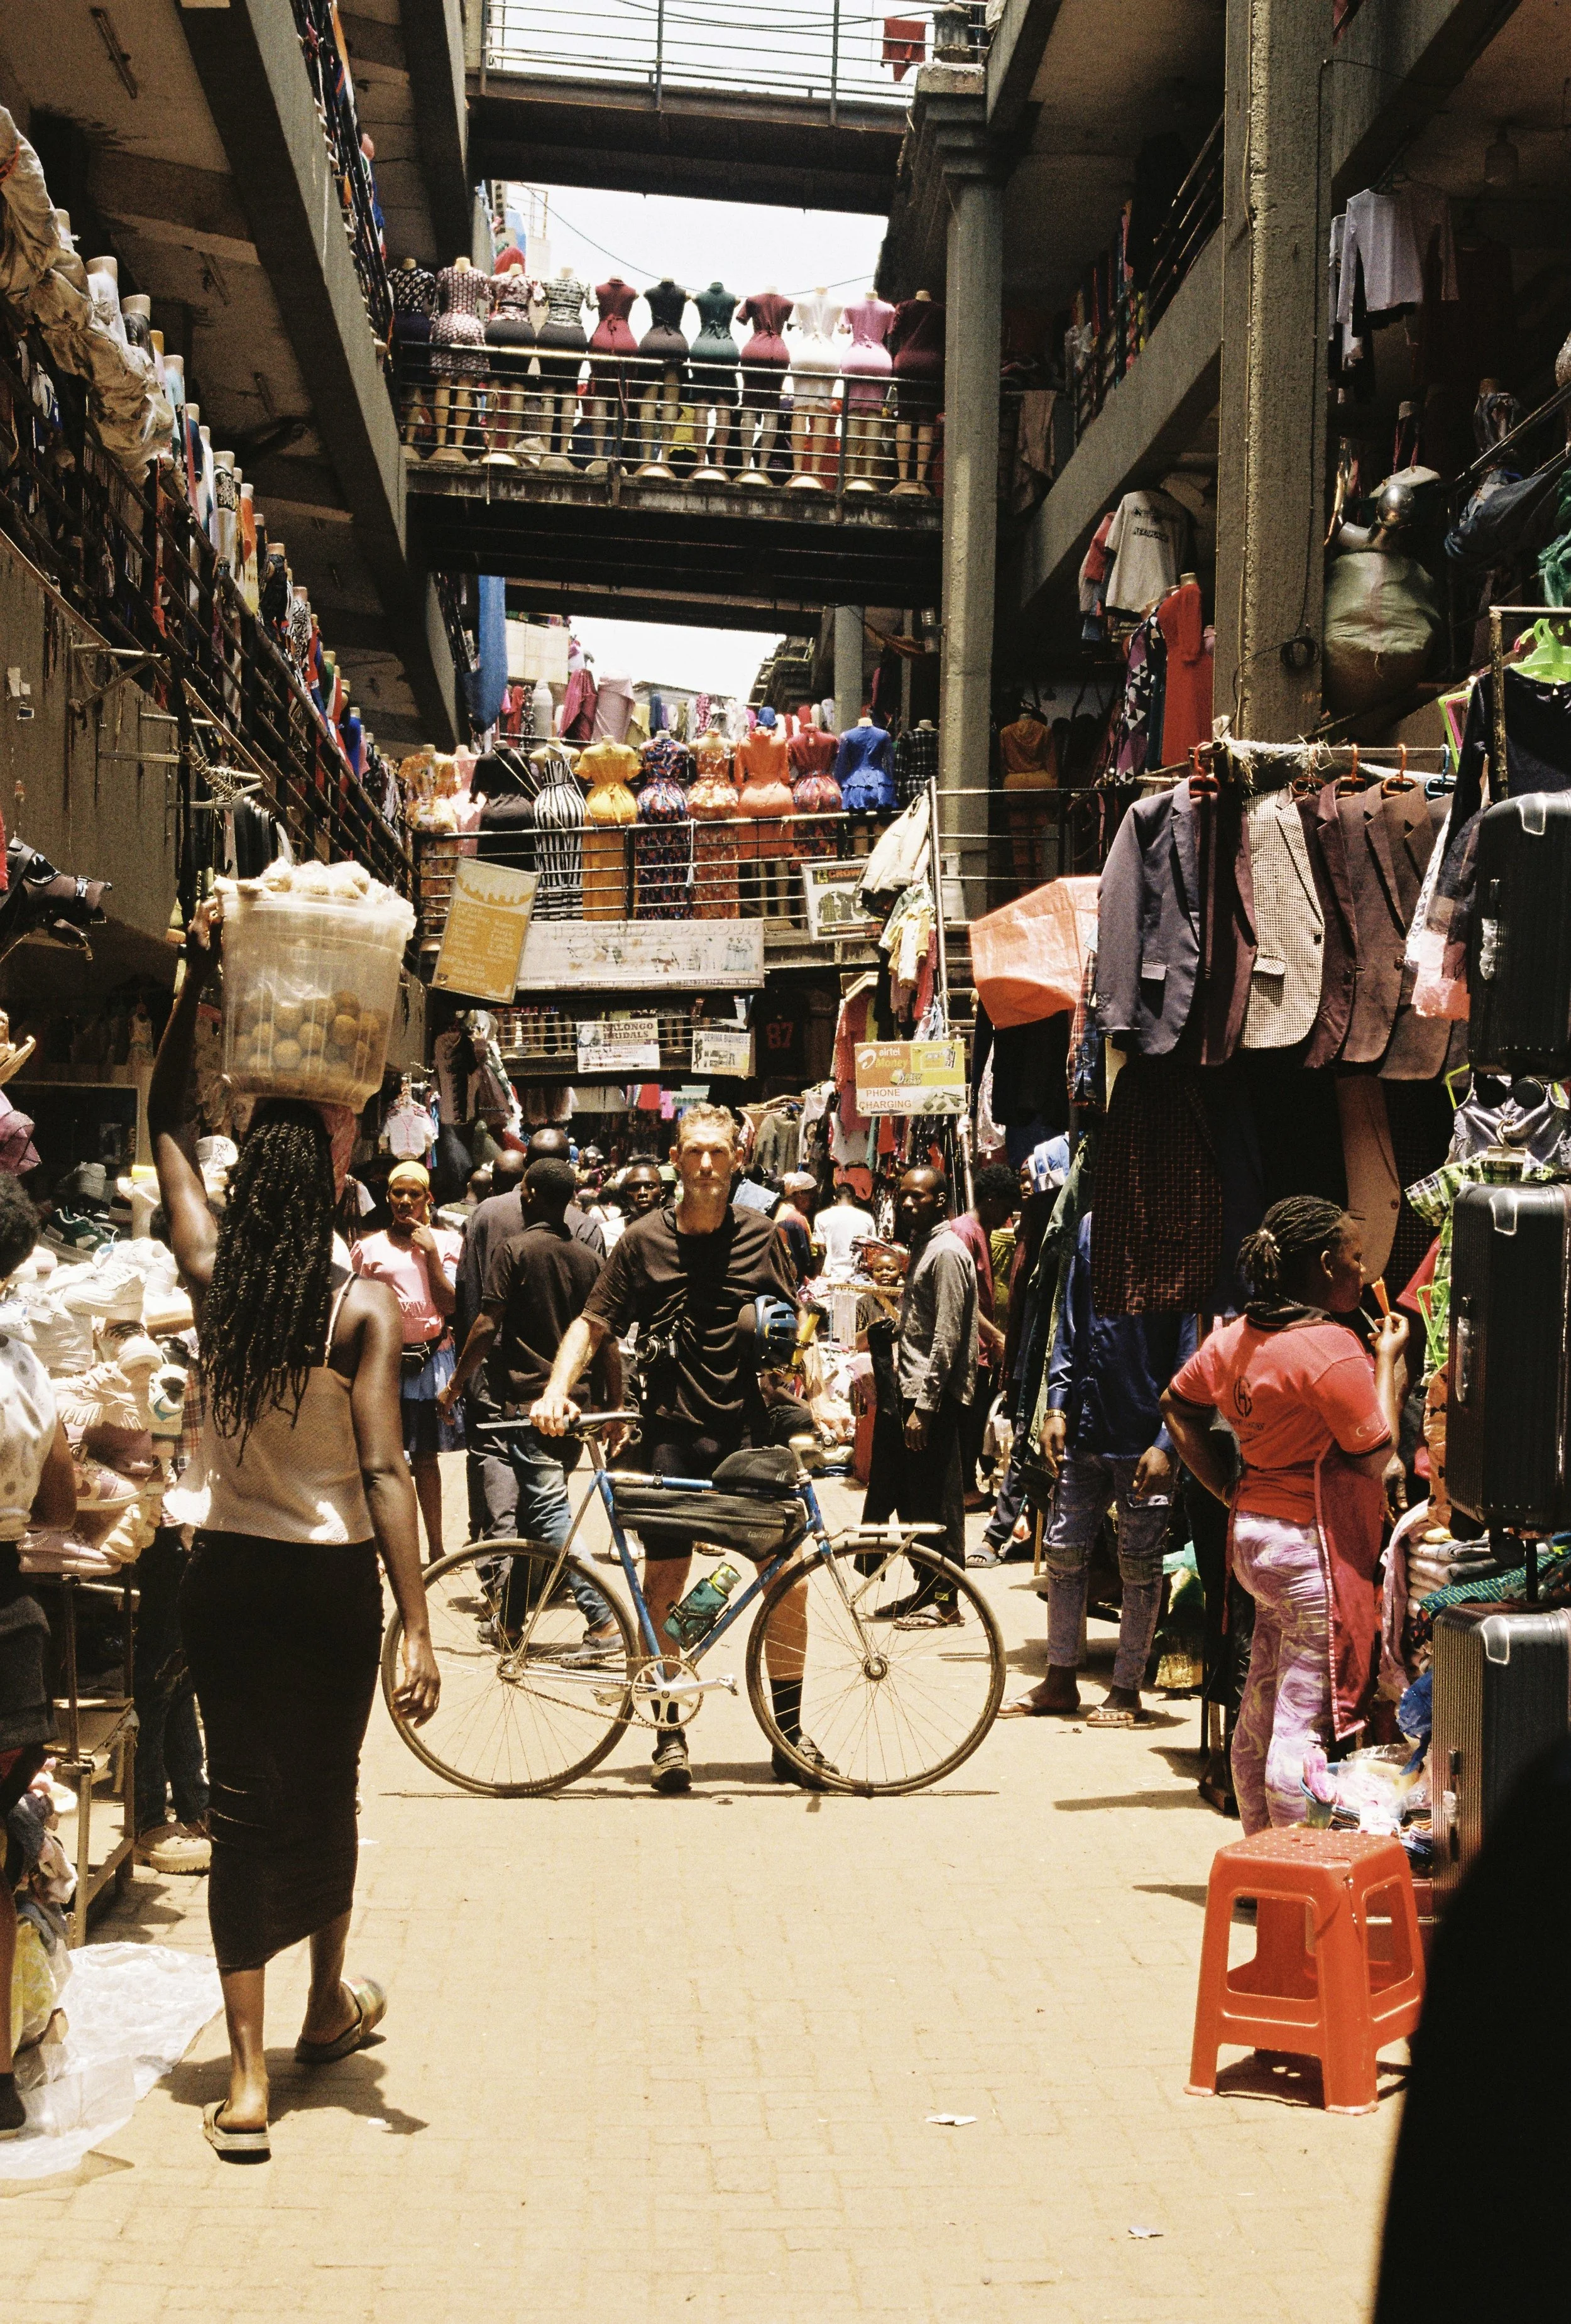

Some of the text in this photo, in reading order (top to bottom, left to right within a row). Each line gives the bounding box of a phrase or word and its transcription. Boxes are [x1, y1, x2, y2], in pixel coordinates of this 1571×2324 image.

[829, 869, 860, 879] CROW
[603, 1022, 654, 1031] NALONGO
[603, 1031, 649, 1039] BRIDALS
[766, 1022, 794, 1049] 87
[879, 1048, 900, 1056] airtel
[875, 1058, 907, 1069] Money
[866, 1088, 900, 1097] PHONE
[858, 1100, 912, 1110] CHARGING
